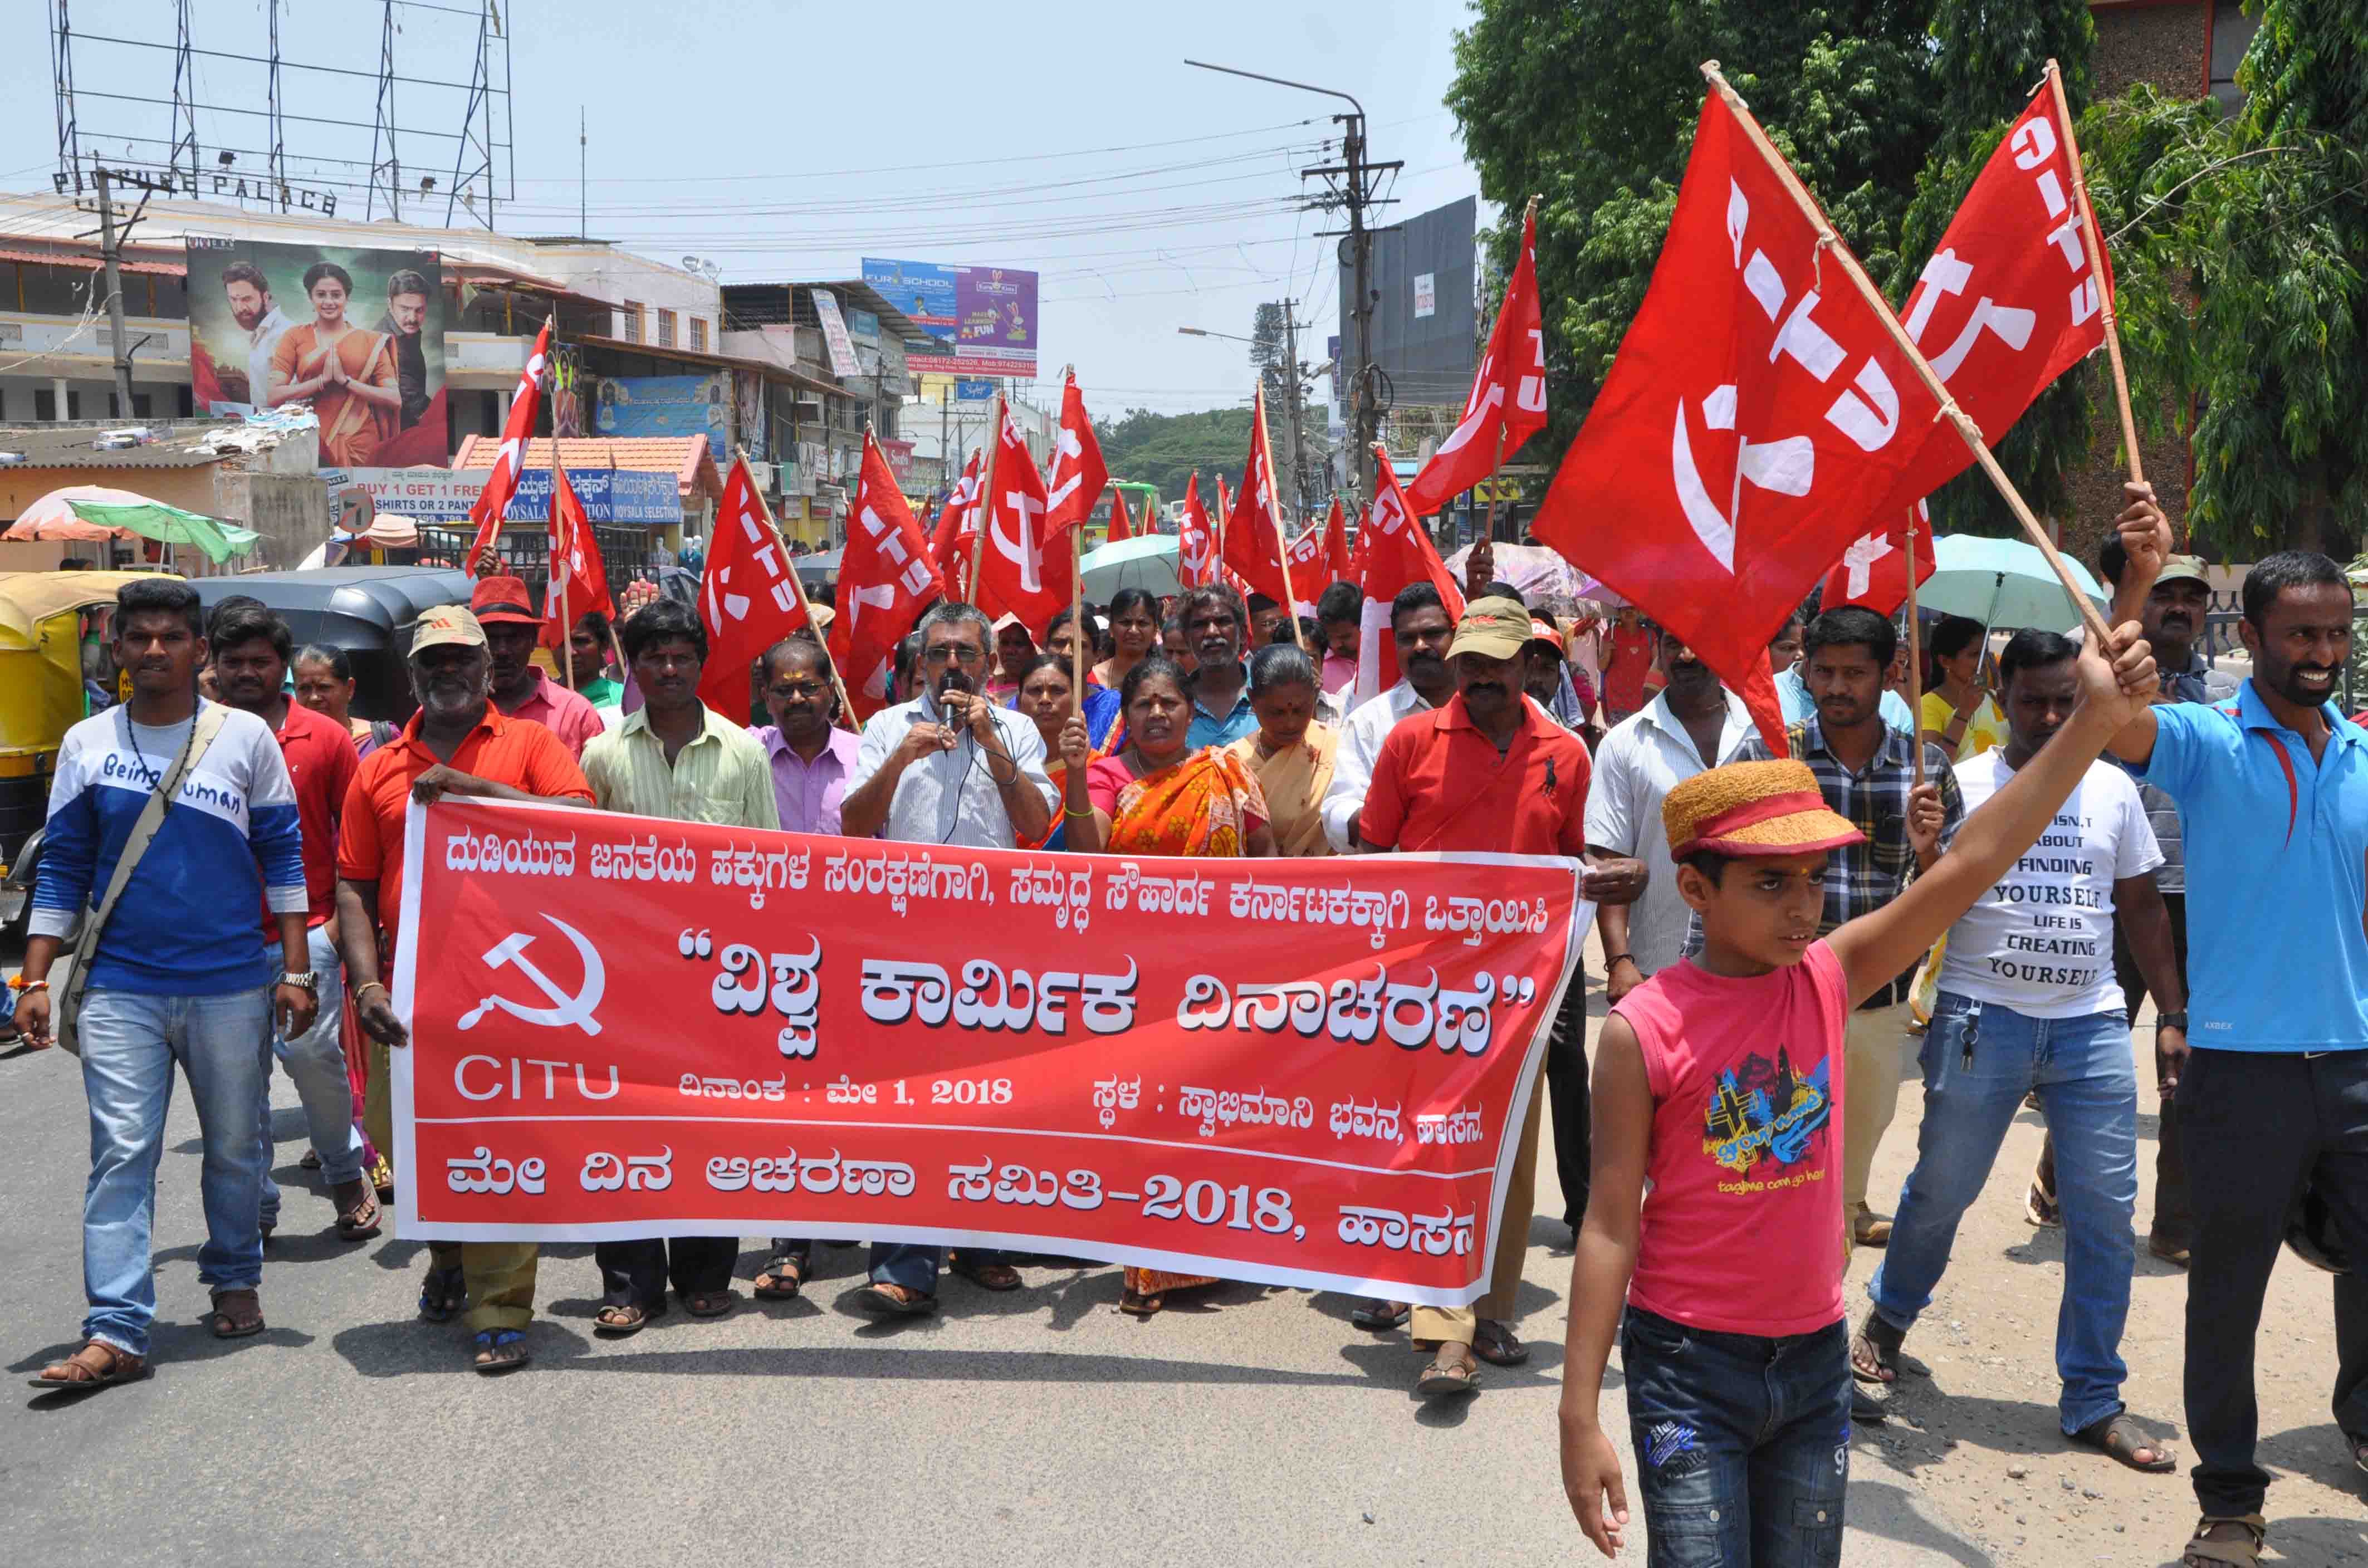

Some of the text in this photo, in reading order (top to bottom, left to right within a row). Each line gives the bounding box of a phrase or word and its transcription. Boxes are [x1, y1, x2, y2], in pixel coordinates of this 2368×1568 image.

[214, 176, 337, 215] PALACE
[375, 499, 415, 511] SHIRTS
[419, 500, 435, 511] OR
[439, 500, 444, 511] 2
[393, 483, 401, 496] 1
[407, 483, 436, 496] GET
[441, 485, 447, 496] 1
[506, 503, 549, 521] OYSALA
[862, 479, 933, 597] ITU
[104, 753, 241, 815] Being uman
[2018, 857, 2093, 876] FINDING
[446, 825, 575, 876] ದುಡಿಯುವ
[590, 833, 696, 883] ಜನತೆಯ
[711, 836, 810, 910] ಹಕ್ಕುಗಳ
[824, 847, 994, 918] ಸಂರಕ್ಷಣೆಗಾಗಿ,
[1107, 861, 1215, 915] ಸೌಹಾರ್ದ
[1229, 873, 1410, 949] ಕರ್ನಾಟಕಕ್ಕಾಗಿ
[1425, 895, 1548, 946] ಒತ್ತಾಯಿಸಿ
[2034, 915, 2082, 929] LIFE IS
[2007, 934, 2095, 956] CREATING
[860, 953, 1139, 1036] ಕಾರ್ಮಿಕ
[454, 1054, 620, 1101] CITU
[678, 1071, 787, 1101] ದಿನಾಂಕ
[826, 1074, 878, 1104] ಮೇ
[931, 1079, 1014, 1105] 2018
[1093, 1074, 1141, 1130] ಸ್ಥಳ
[1180, 1085, 1314, 1137] ಸ್ವಾಭಿಮಾನಿ
[1329, 1094, 1405, 1146] ಭವನ,
[447, 1145, 547, 1194] ಮೇ
[579, 1144, 673, 1192] ದಿನ
[706, 1146, 917, 1197] ಆಚರಣಾ
[1338, 1200, 1476, 1256] ಹಾಸನ
[1767, 1177, 1790, 1189] can
